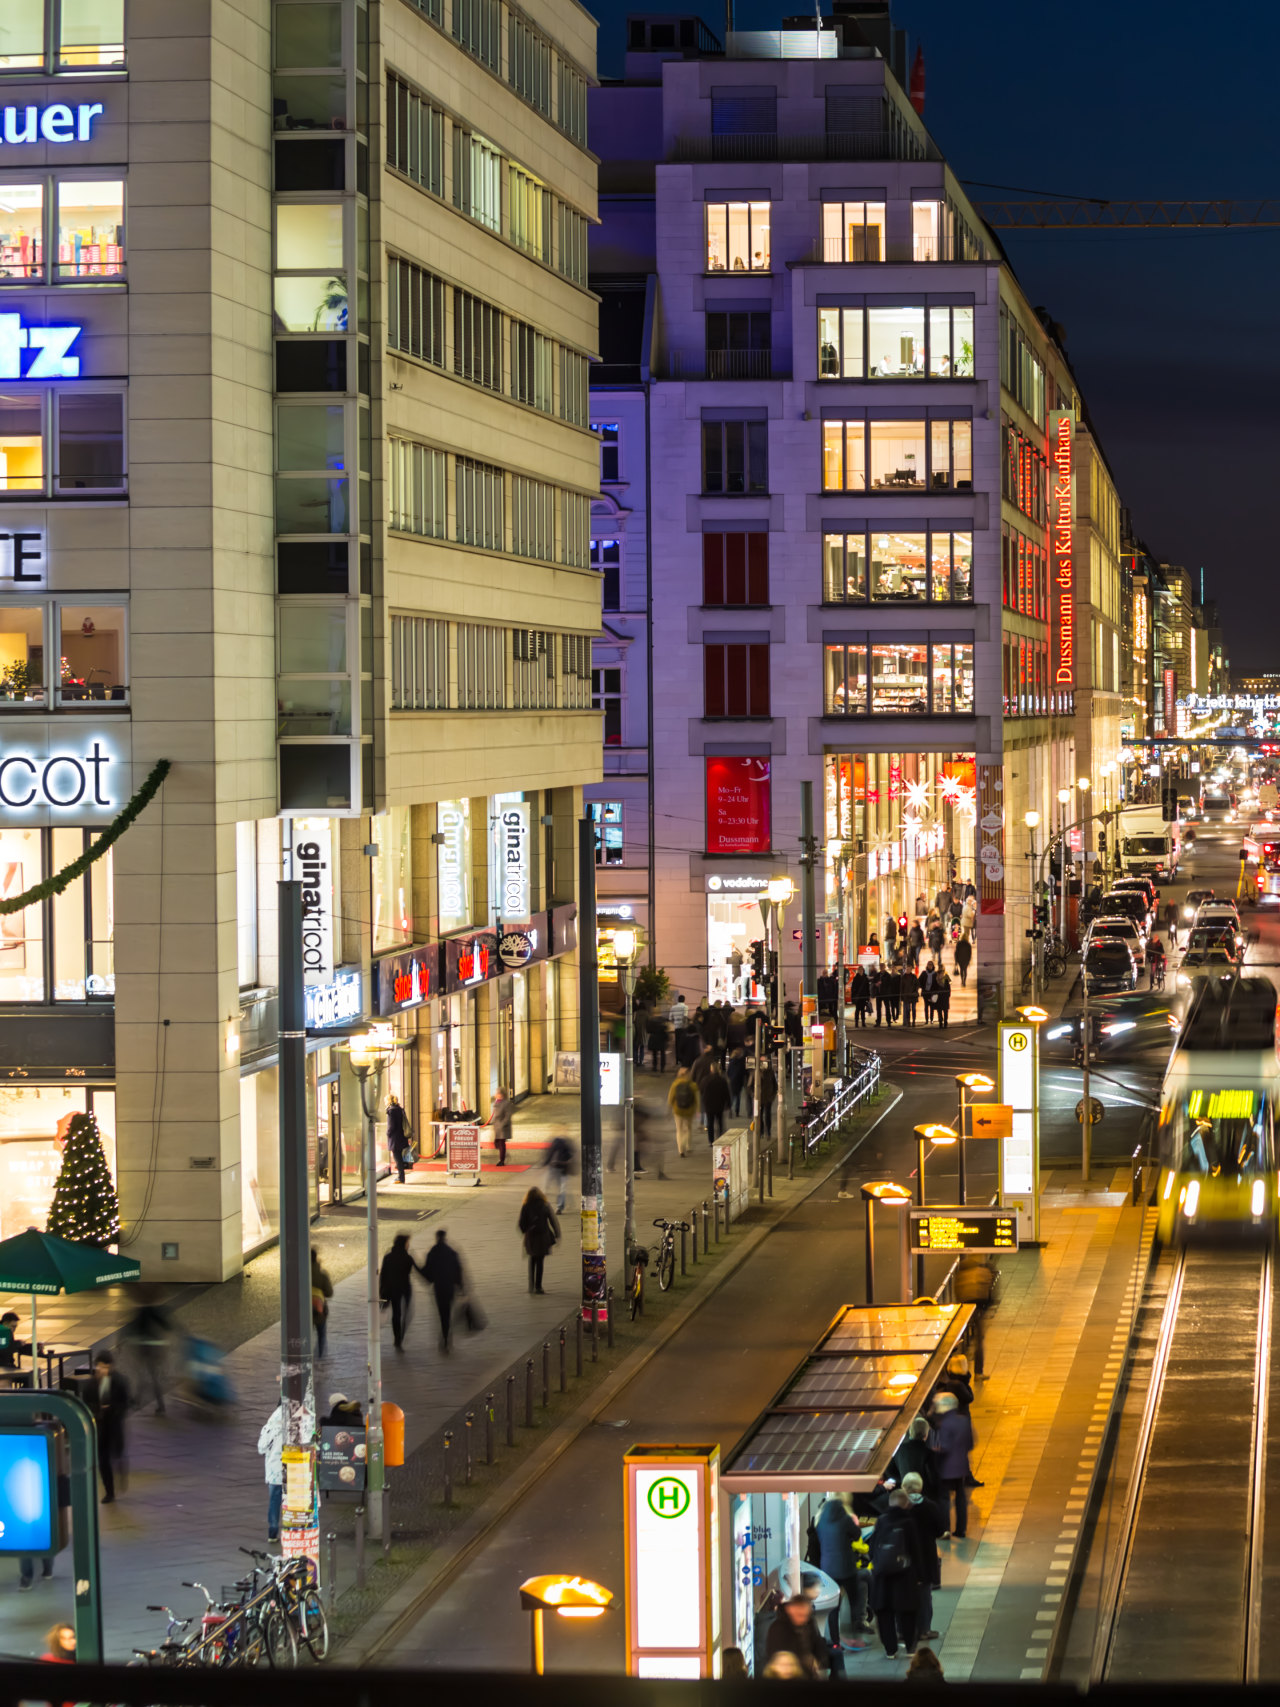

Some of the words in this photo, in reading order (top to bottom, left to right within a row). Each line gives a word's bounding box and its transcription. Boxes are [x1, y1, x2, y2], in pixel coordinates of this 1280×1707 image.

[0, 103, 103, 144] uer
[1054, 417, 1072, 555] KulturKaufhaus
[1055, 560, 1073, 588] das
[1055, 595, 1073, 684] Dussmann
[503, 812, 526, 914] ginatricot
[723, 877, 769, 888] vodafone
[31, 1283, 57, 1292] COFFEE
[753, 1533, 773, 1541] spot
